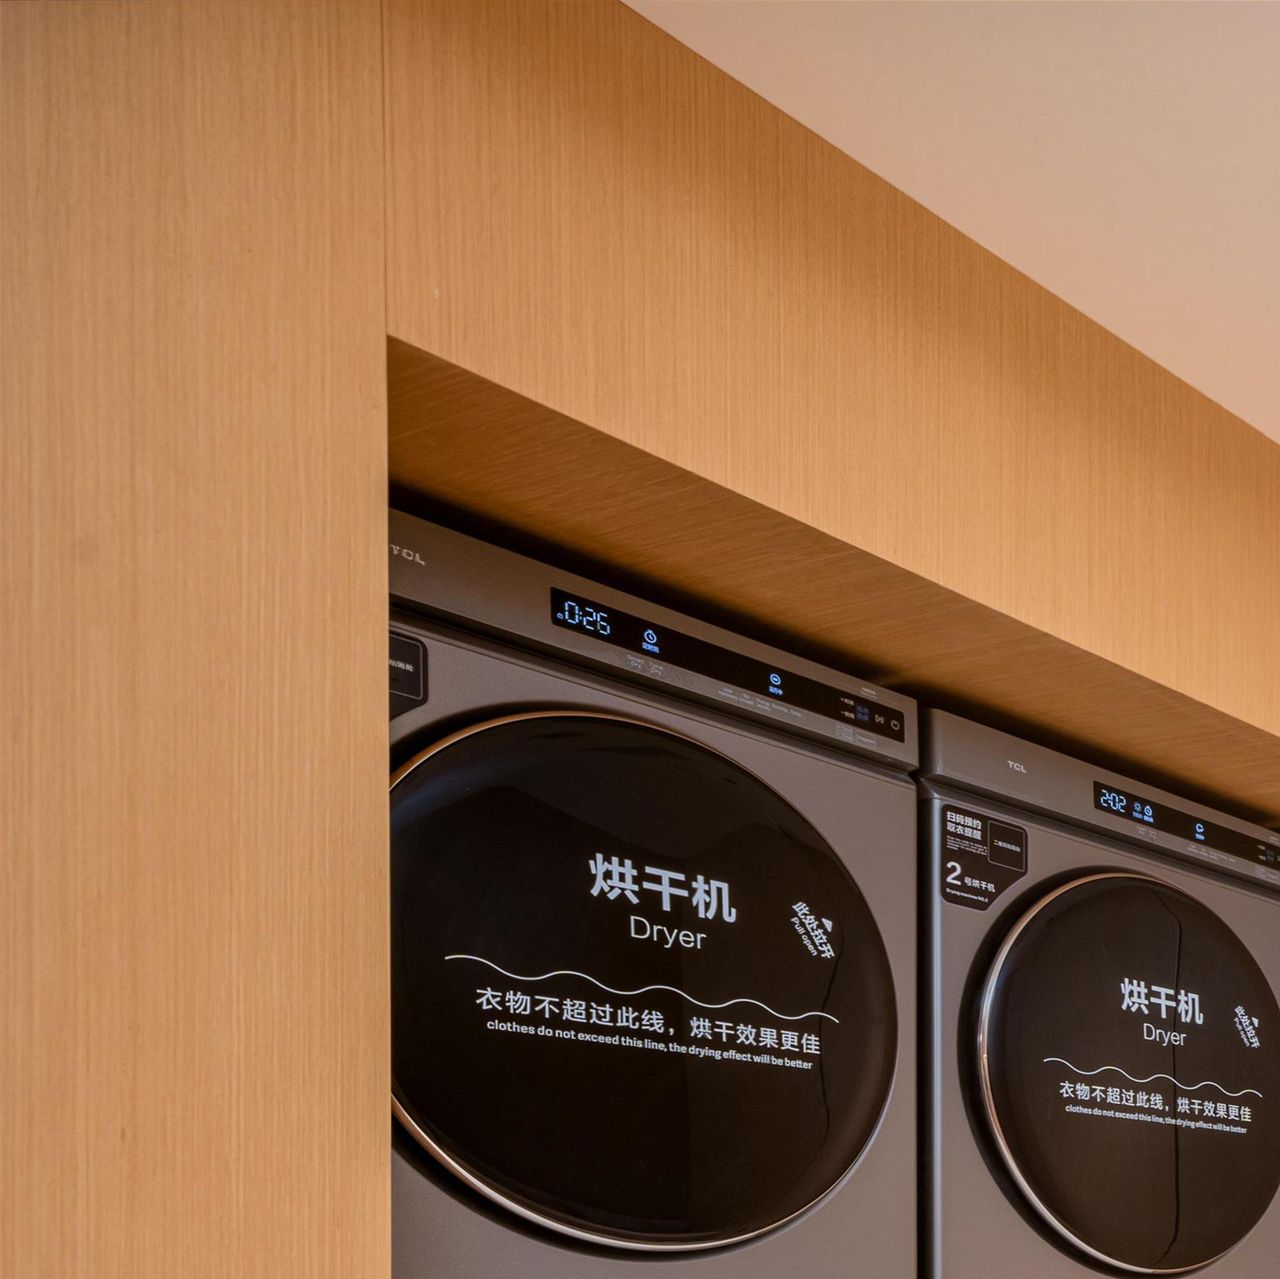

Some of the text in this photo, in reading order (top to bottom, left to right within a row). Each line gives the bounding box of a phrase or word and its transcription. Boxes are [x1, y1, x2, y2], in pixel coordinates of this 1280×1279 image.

[390, 544, 426, 565] TCL
[564, 601, 610, 634] 0:26
[1007, 760, 1027, 774] TCL
[588, 852, 737, 924] 烘干机
[946, 862, 962, 886] 2
[630, 916, 706, 950] Dryer
[790, 917, 818, 956] Pull open
[792, 902, 835, 958] 此处拉开
[1120, 977, 1204, 1024] 烘干机
[476, 988, 821, 1055] 衣物不超过此线，烘干效果更佳
[1143, 1024, 1186, 1046] Dryer
[1234, 1005, 1260, 1048] 此处拉开
[487, 1020, 812, 1069] clothes do not exceed this line, the drying effect will be better
[1060, 1081, 1252, 1122] 衣物不超过此线，烘干效果更佳
